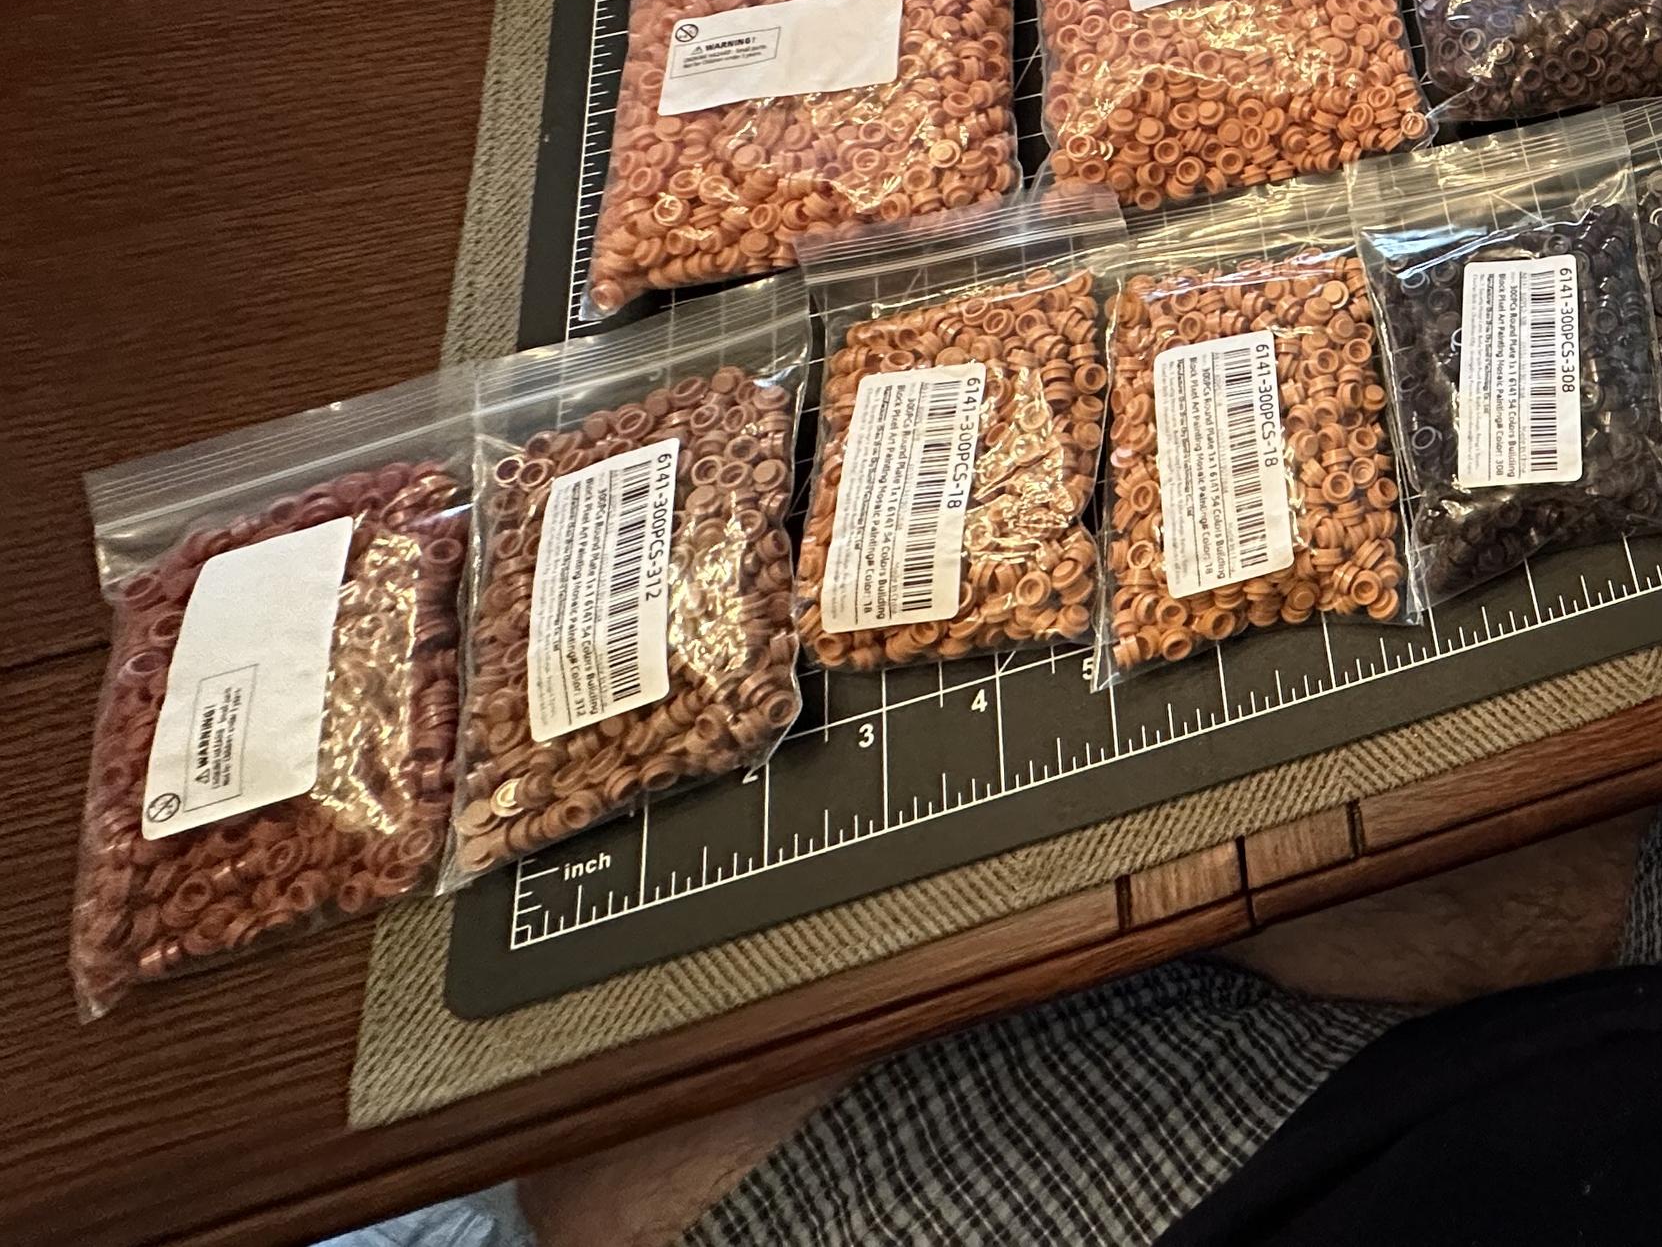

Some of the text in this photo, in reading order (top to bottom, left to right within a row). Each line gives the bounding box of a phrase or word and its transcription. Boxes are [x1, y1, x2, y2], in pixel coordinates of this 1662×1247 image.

[1559, 267, 1574, 392] 6141-300PCS-308
[1255, 343, 1278, 468] 6141-300PCS-18
[1508, 377, 1516, 398] 6141
[946, 377, 979, 509] 6141-300PCS-18
[645, 451, 671, 601] 6141-300PCS-312
[858, 723, 875, 748] 3
[971, 688, 988, 713] 4
[563, 852, 612, 882] inch
